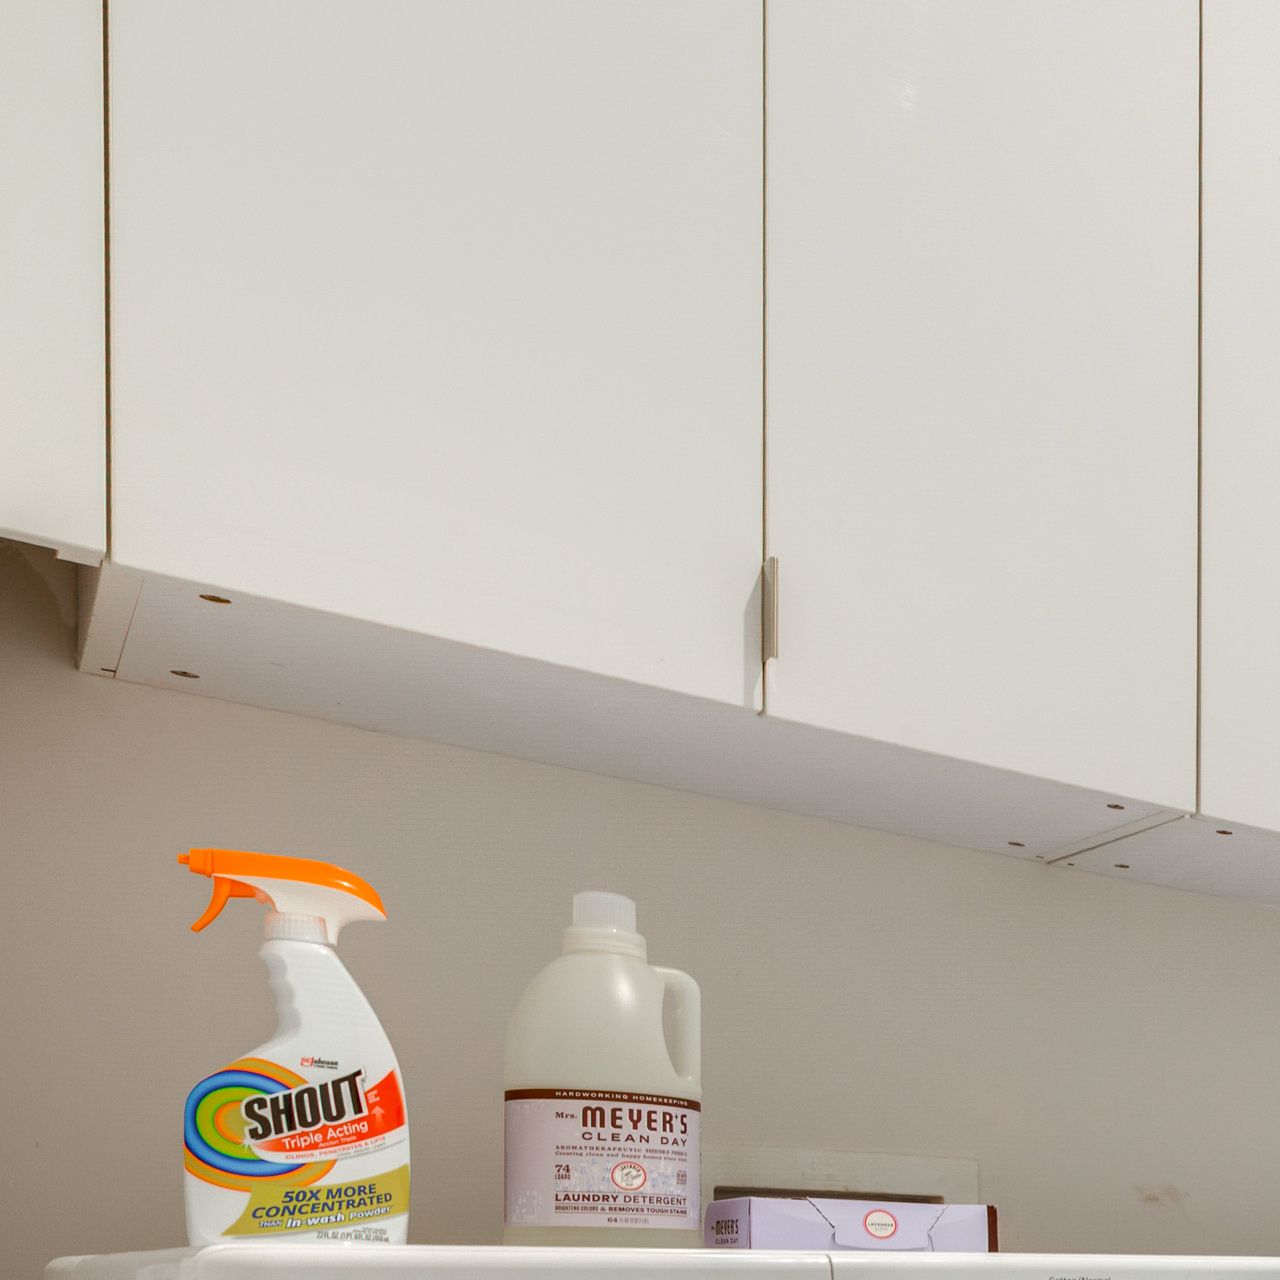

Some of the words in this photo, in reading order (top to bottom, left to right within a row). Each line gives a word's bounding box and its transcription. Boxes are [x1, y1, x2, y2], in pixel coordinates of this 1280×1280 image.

[244, 1069, 364, 1141] SHOUT
[555, 1091, 628, 1100] HARDWORKING
[632, 1095, 688, 1106] HOMEKEEPING
[555, 1111, 578, 1119] Mrs.
[581, 1106, 688, 1134] MEYER'S
[281, 1132, 323, 1149] Triple
[326, 1121, 369, 1141] Acting
[581, 1131, 650, 1143] CLEAN
[660, 1136, 688, 1147] DAY
[555, 1164, 570, 1174] 74
[281, 1188, 322, 1204] 50X
[326, 1183, 377, 1200] MORE
[555, 1193, 619, 1203] LAUNDRY
[623, 1195, 687, 1206] DETERGENT
[251, 1192, 393, 1219] CONCENTRATED
[258, 1218, 283, 1228] THAN
[349, 1205, 392, 1220] Powder
